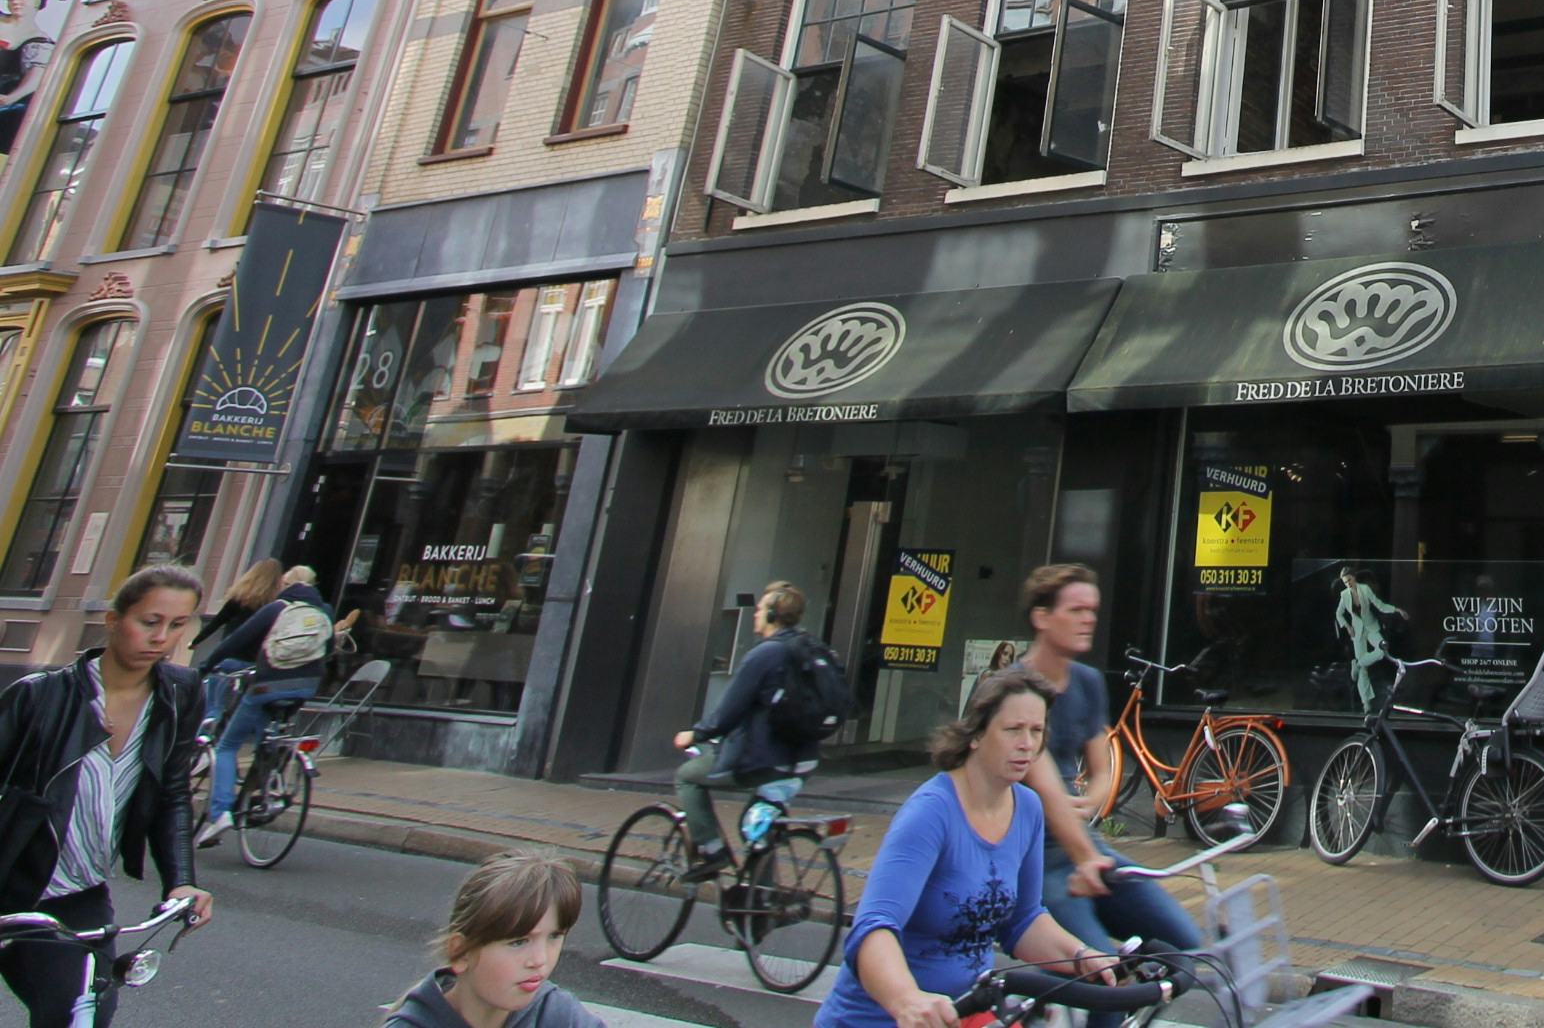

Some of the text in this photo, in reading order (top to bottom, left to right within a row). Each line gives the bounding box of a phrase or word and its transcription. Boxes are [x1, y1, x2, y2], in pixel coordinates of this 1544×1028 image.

[352, 351, 393, 390] 28
[1235, 372, 1465, 401] FRED DE LA BRETONIERE
[211, 413, 264, 425] BAKKERIJ
[708, 404, 878, 426] FRED DE LA BRETONIERE
[191, 420, 277, 438] BLANCHE
[1205, 467, 1267, 493] VERHUURD
[422, 545, 487, 561] BAKKERIJ
[397, 563, 500, 592] BLANCHE
[900, 552, 947, 591] VERHUURD
[1200, 570, 1262, 584] 050 311 30 31
[420, 595, 441, 604] BROOD
[447, 596, 471, 605] BANKET
[474, 597, 496, 605] LUNCH
[1452, 597, 1523, 617] WIJ ZIJN
[1443, 616, 1534, 633] GESLOTEN
[883, 646, 937, 664] 050 311 30 31
[1460, 658, 1479, 666] SHOP
[1492, 659, 1518, 667] ONLINE
